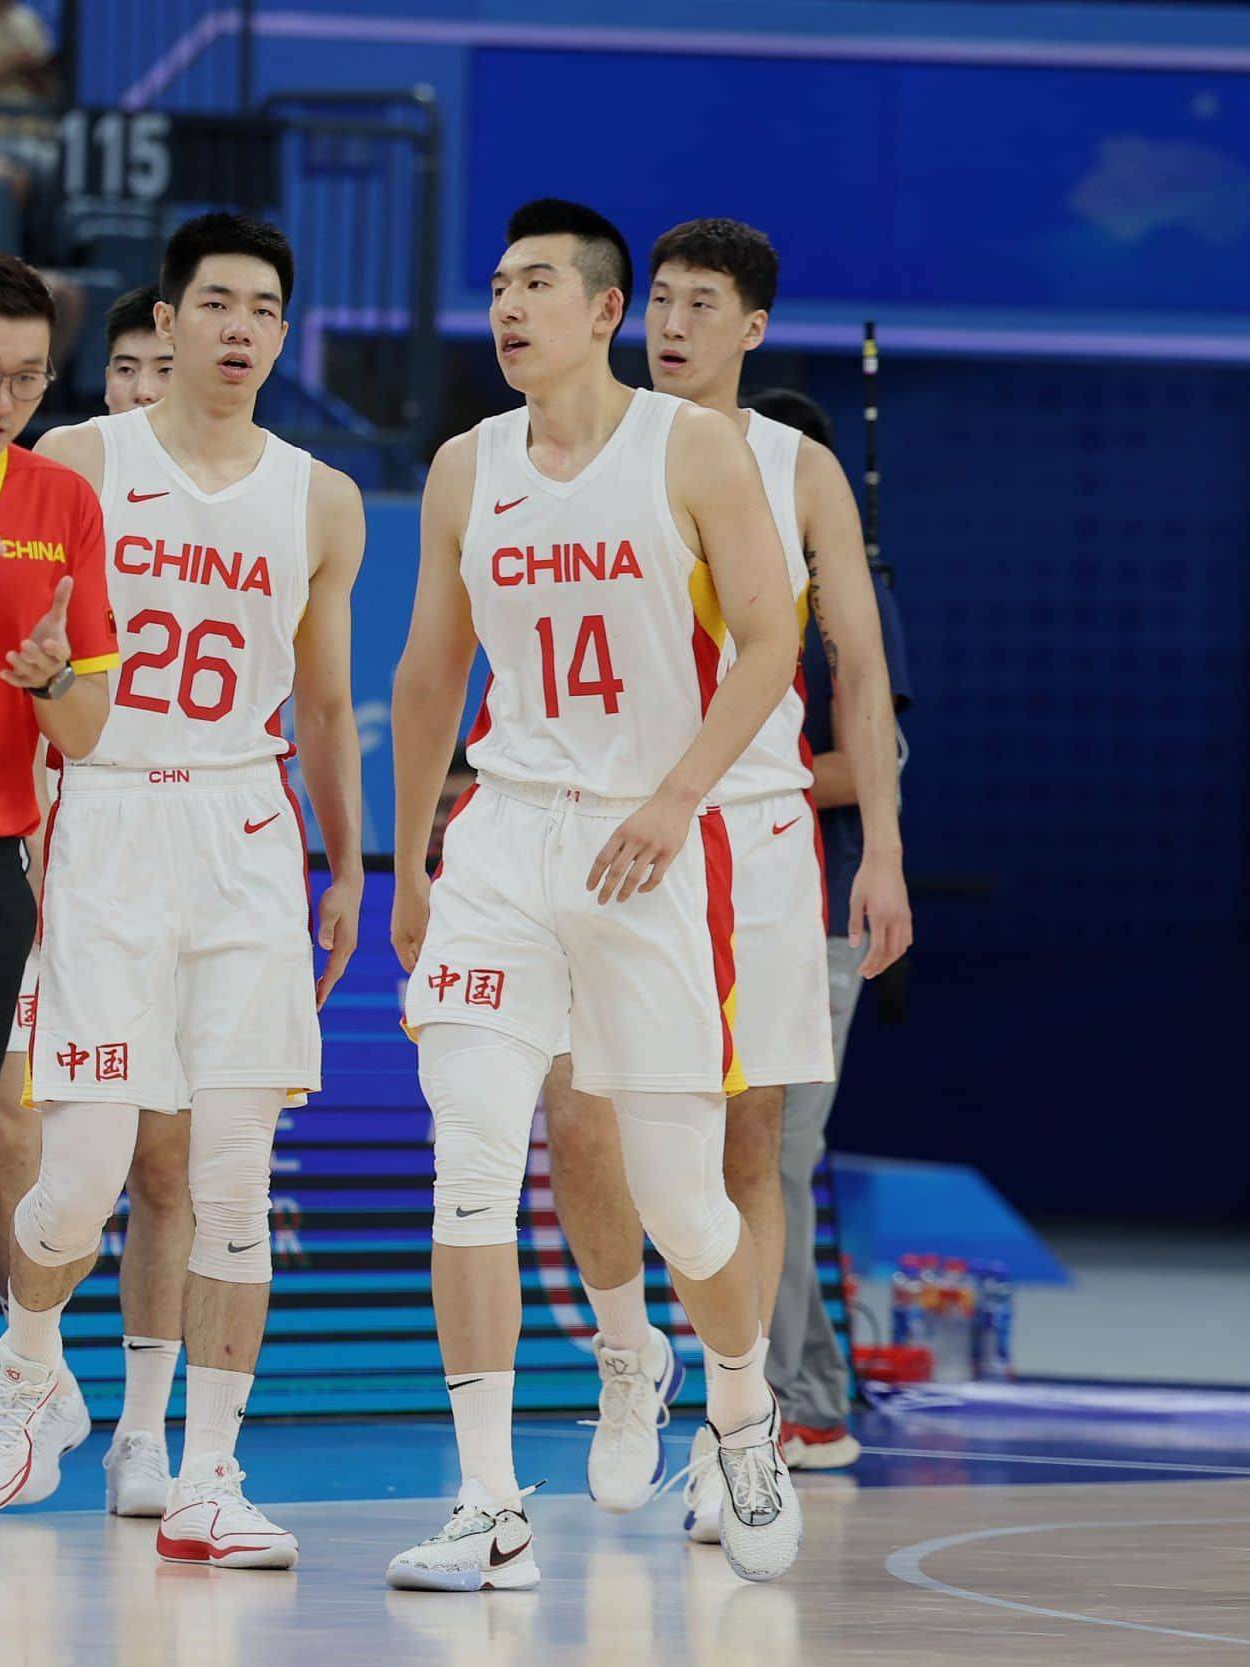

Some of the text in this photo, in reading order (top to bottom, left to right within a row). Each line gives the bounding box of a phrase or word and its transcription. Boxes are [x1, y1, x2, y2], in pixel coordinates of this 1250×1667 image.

[57, 111, 171, 199] 115
[113, 535, 273, 597] CHINA
[491, 540, 644, 587] CHINA
[114, 608, 246, 723] 26
[535, 614, 625, 719] 14
[148, 769, 190, 784] CHN
[427, 963, 505, 1010] 中国
[56, 1041, 129, 1082] 中国
